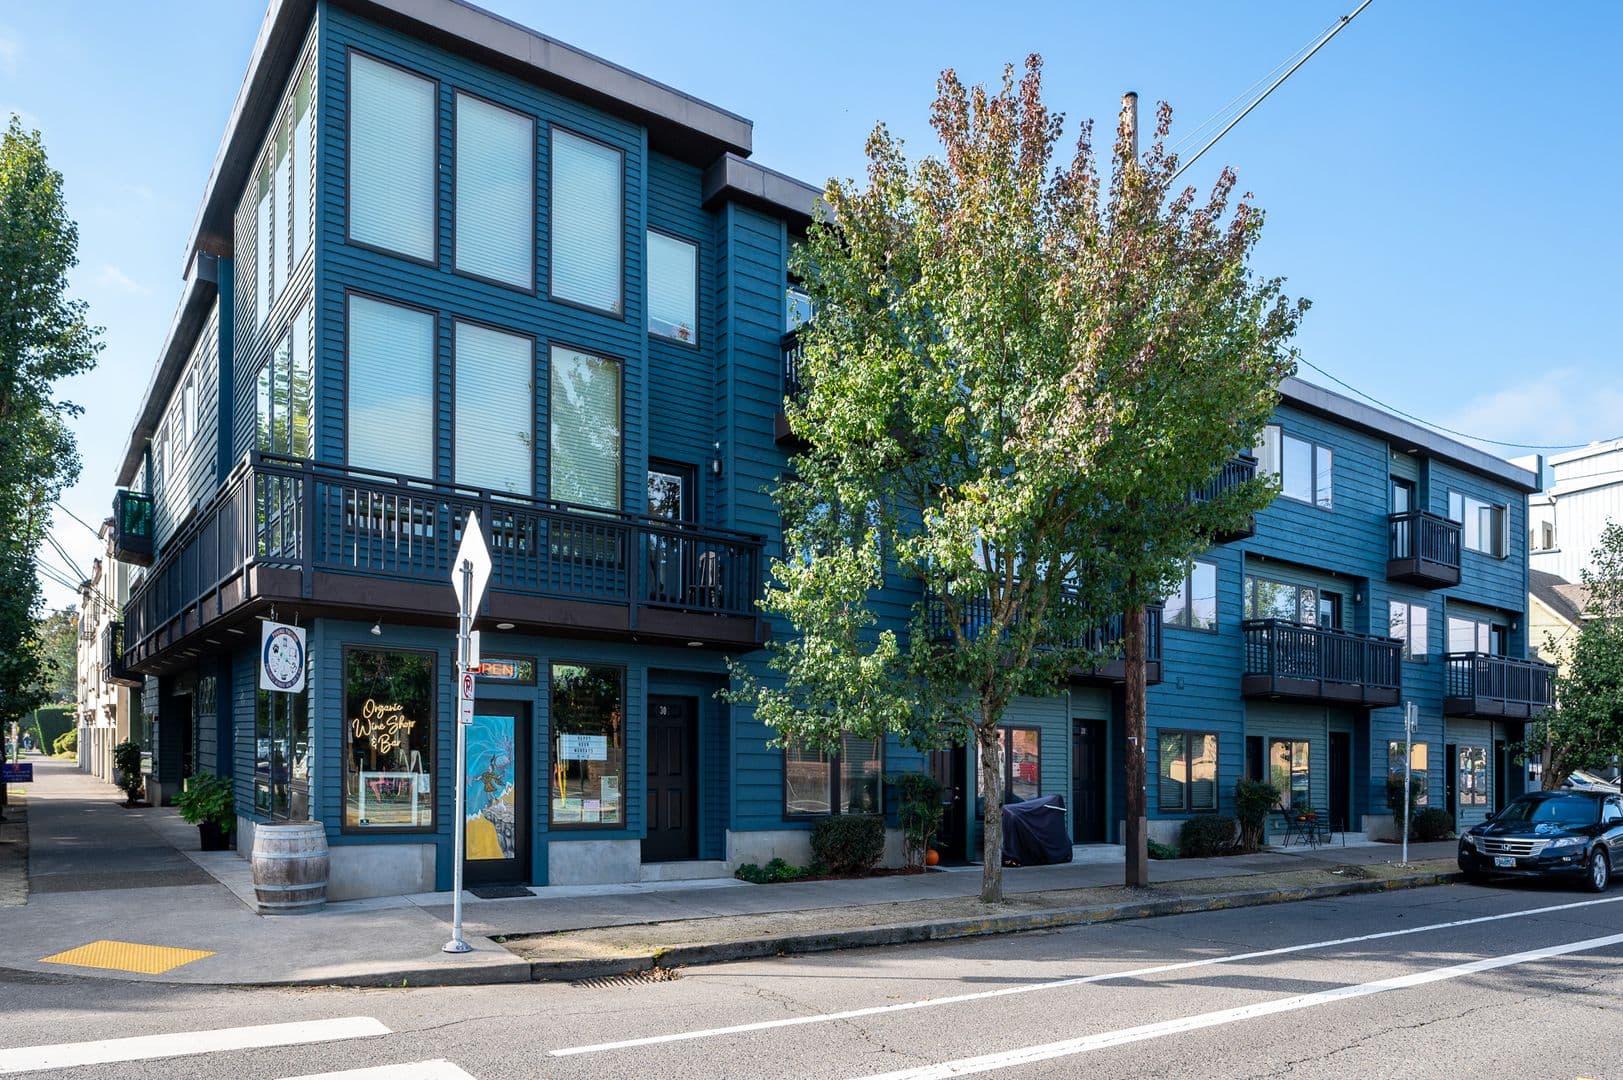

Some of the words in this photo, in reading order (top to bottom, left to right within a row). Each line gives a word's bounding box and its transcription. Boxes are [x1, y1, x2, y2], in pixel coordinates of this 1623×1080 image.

[363, 699, 403, 719] Organic
[352, 718, 386, 738] Wine
[386, 715, 416, 735] Shop
[371, 734, 378, 750] &
[378, 733, 401, 754] Bar
